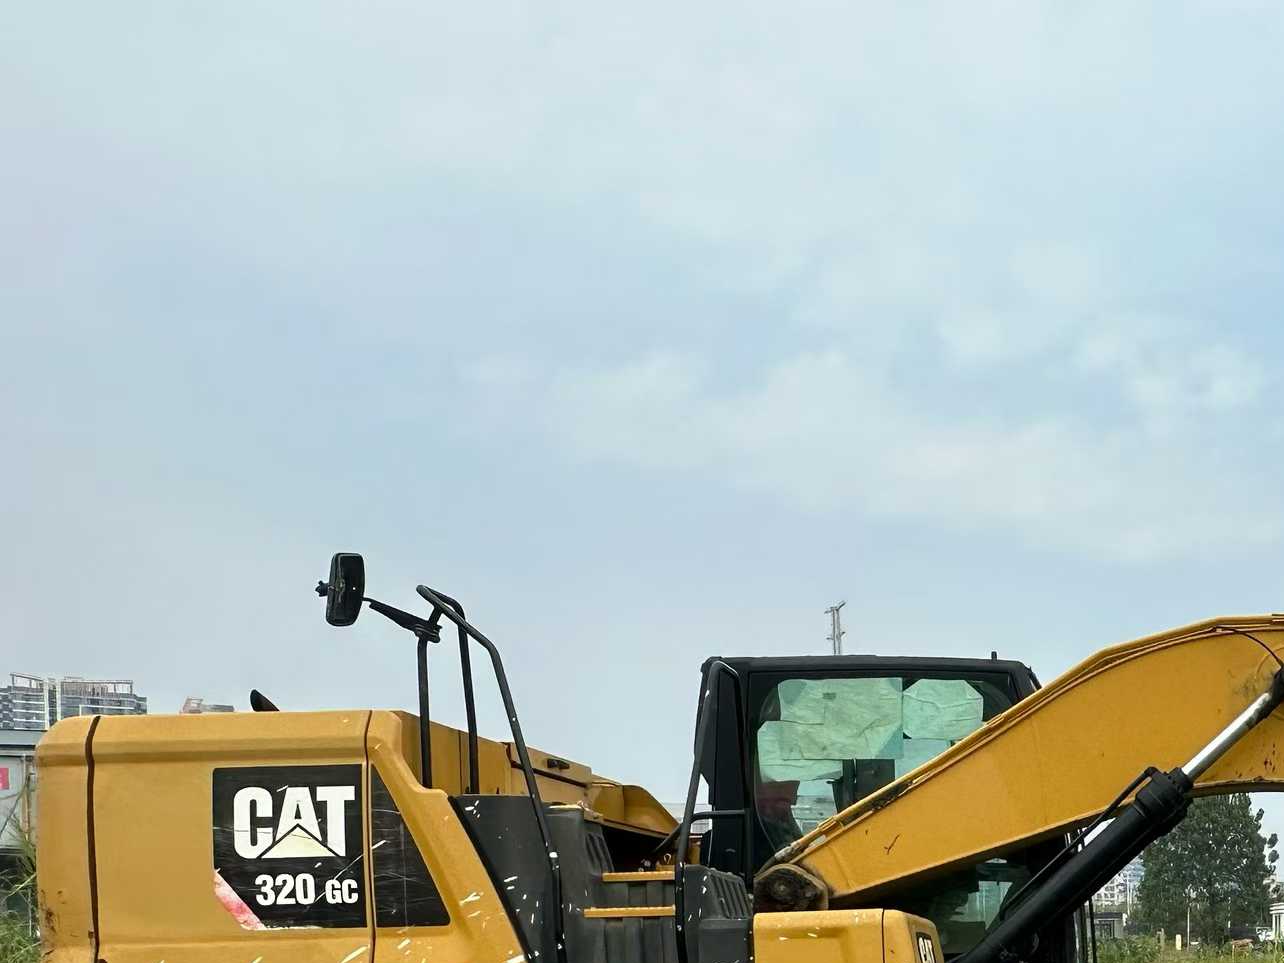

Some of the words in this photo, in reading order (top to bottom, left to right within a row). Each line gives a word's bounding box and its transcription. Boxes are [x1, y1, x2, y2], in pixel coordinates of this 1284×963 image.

[233, 785, 355, 860] CAT
[254, 873, 316, 906] 320
[325, 878, 359, 905] GC
